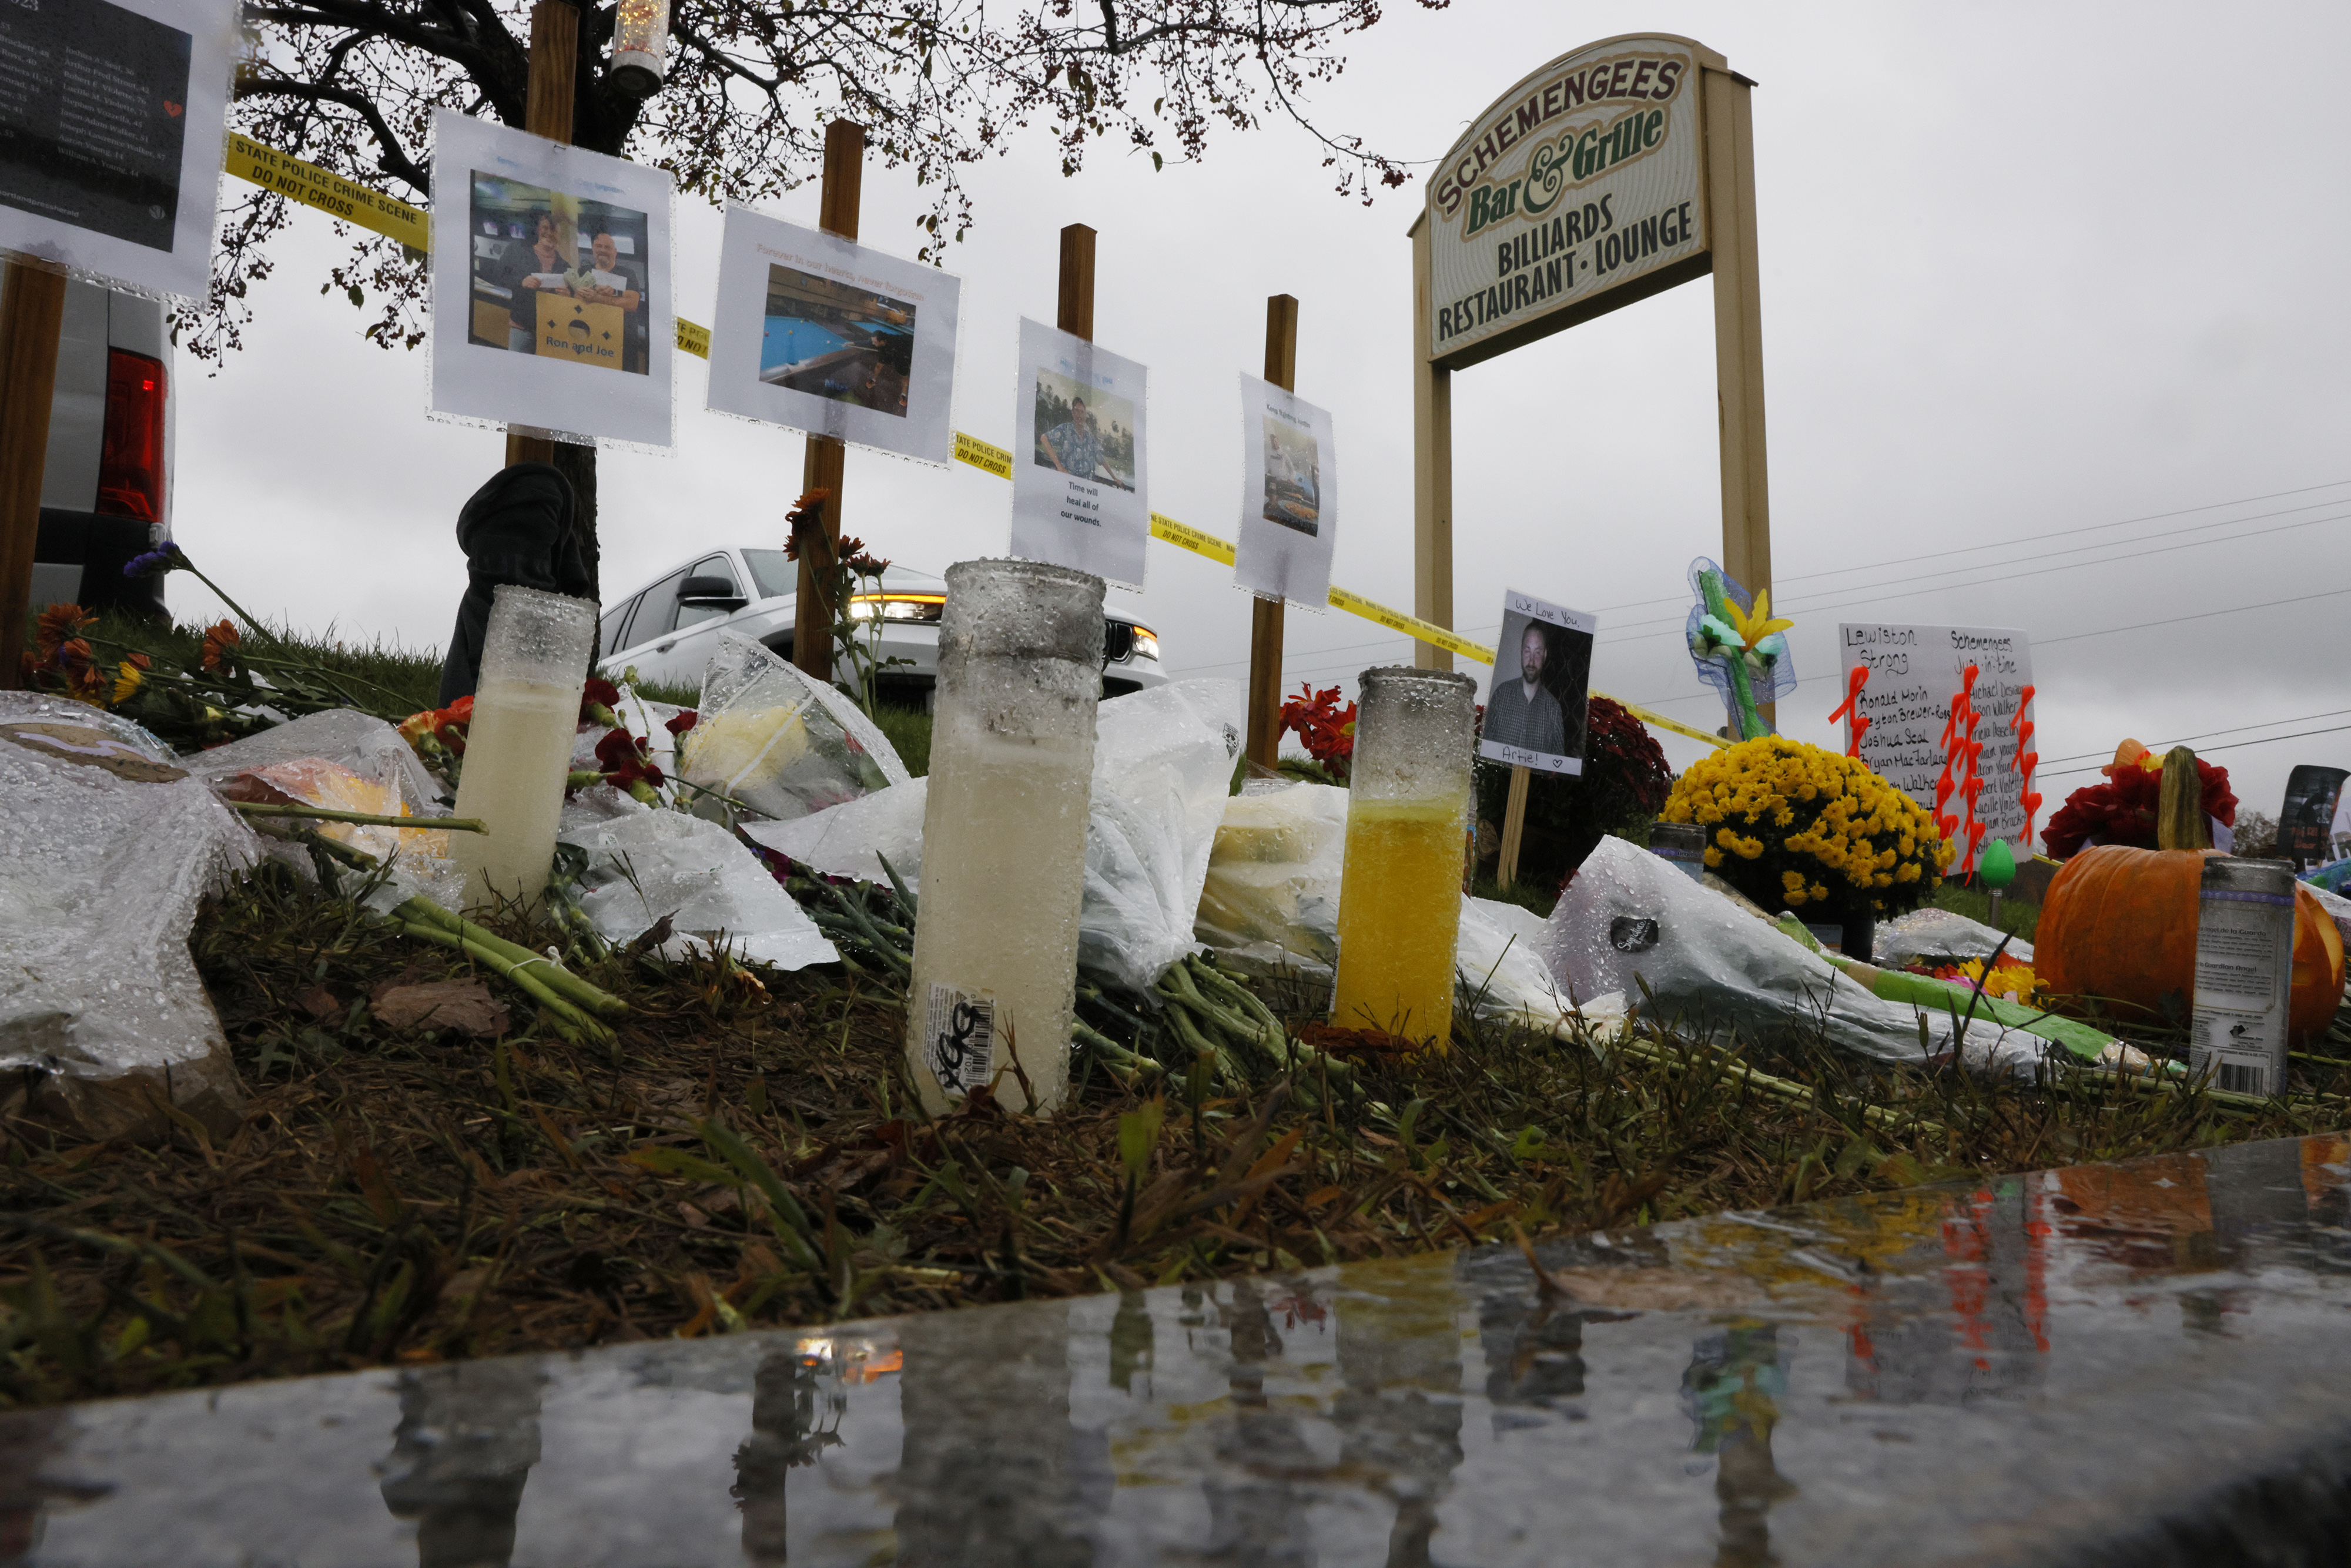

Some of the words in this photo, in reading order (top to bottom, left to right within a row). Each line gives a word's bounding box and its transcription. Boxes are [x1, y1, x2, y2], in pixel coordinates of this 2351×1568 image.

[63, 70, 91, 86] Robert
[64, 59, 91, 73] Arthur
[93, 68, 111, 81] Fred
[60, 120, 86, 136] Joseph
[85, 116, 108, 129] Adam
[1438, 59, 1682, 215] SCHEMENGEES
[236, 140, 277, 167] STATE
[282, 160, 329, 189] POLICE
[333, 181, 375, 207] CRIME
[378, 199, 418, 225] SCENE
[1467, 179, 1521, 235] Bar
[1523, 134, 1574, 214] &
[1572, 109, 1663, 181] Grille
[252, 165, 274, 184] DO
[276, 175, 306, 196] NOT
[308, 188, 354, 216] CROSS
[1498, 193, 1613, 278] BILLIARDS
[806, 260, 823, 271] our
[858, 274, 883, 289] never
[1439, 250, 1576, 343] RESTAURANT
[1595, 200, 1693, 277] LOUNGE
[545, 336, 568, 349] Ron
[571, 343, 594, 355] and
[596, 345, 615, 358] Joe
[956, 434, 971, 448] TATE
[972, 441, 995, 458] POLICE
[996, 451, 1013, 464] CRIM
[957, 448, 969, 459] DO
[969, 453, 984, 465] NOT
[984, 459, 1007, 474] CROSS
[1069, 481, 1085, 494] Time
[1086, 488, 1099, 497] will
[1066, 495, 1081, 507] heal
[1082, 500, 1091, 510] all
[1091, 503, 1099, 511] of
[1060, 511, 1073, 519] our
[1074, 514, 1102, 528] wounds.
[1157, 516, 1173, 529] STATE
[1173, 522, 1191, 537] POLICE
[1191, 530, 1207, 543] CRIME
[1207, 536, 1223, 549] SCENE
[1163, 530, 1172, 539] DO
[1171, 533, 1183, 543] NOT
[1181, 537, 1200, 551] CROSS
[1515, 598, 1532, 612] We
[1536, 602, 1555, 620] Love
[1846, 627, 1917, 647] Lewiston
[1860, 649, 1909, 678] Strong
[1856, 689, 1898, 709] Ronald
[1901, 685, 1928, 702] Morin
[1992, 698, 2019, 716] Walker
[1859, 731, 1903, 749] Joshua
[1905, 728, 1930, 745] Seal
[1502, 746, 1539, 766] Artie!
[1894, 749, 1953, 768] MacFarlane
[1617, 920, 1647, 951] Signature
[2205, 962, 2234, 971] Guardian
[2235, 965, 2258, 973] Angel
